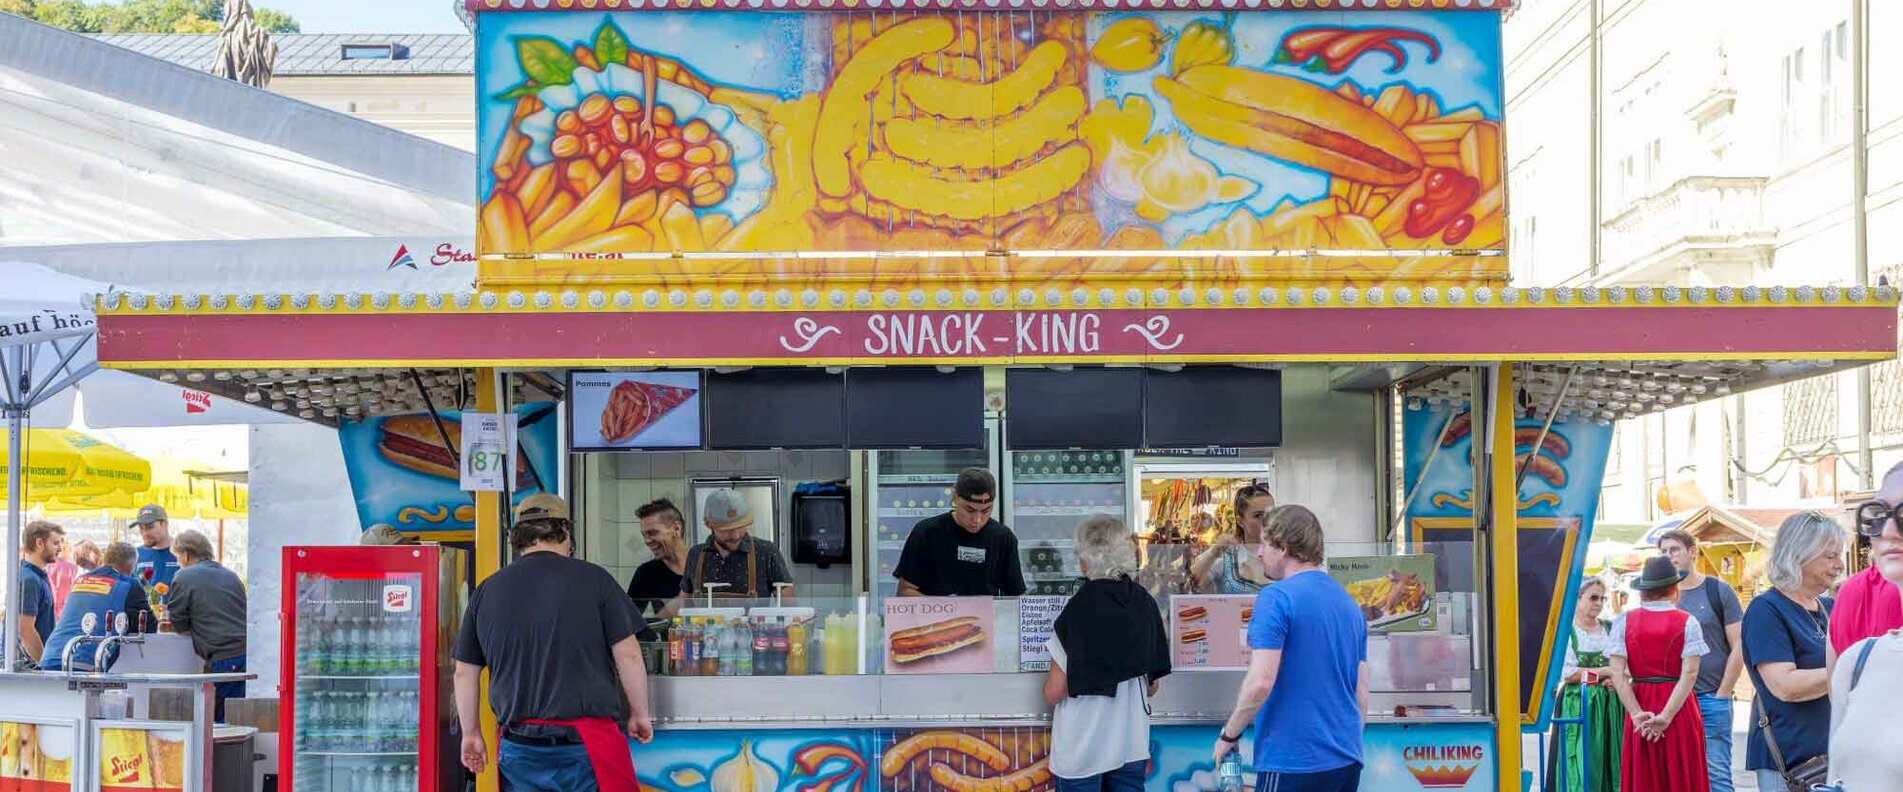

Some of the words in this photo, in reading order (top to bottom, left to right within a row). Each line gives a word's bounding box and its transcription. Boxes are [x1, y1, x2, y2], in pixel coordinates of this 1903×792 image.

[431, 243, 477, 266] Sta
[0, 315, 42, 337] auf
[474, 451, 502, 471] 87
[886, 604, 917, 614] HOT
[921, 604, 954, 614] DOG
[1022, 645, 1043, 654] Stiegl
[1403, 745, 1484, 761] CHILIKING
[111, 753, 143, 776] Stiegl
